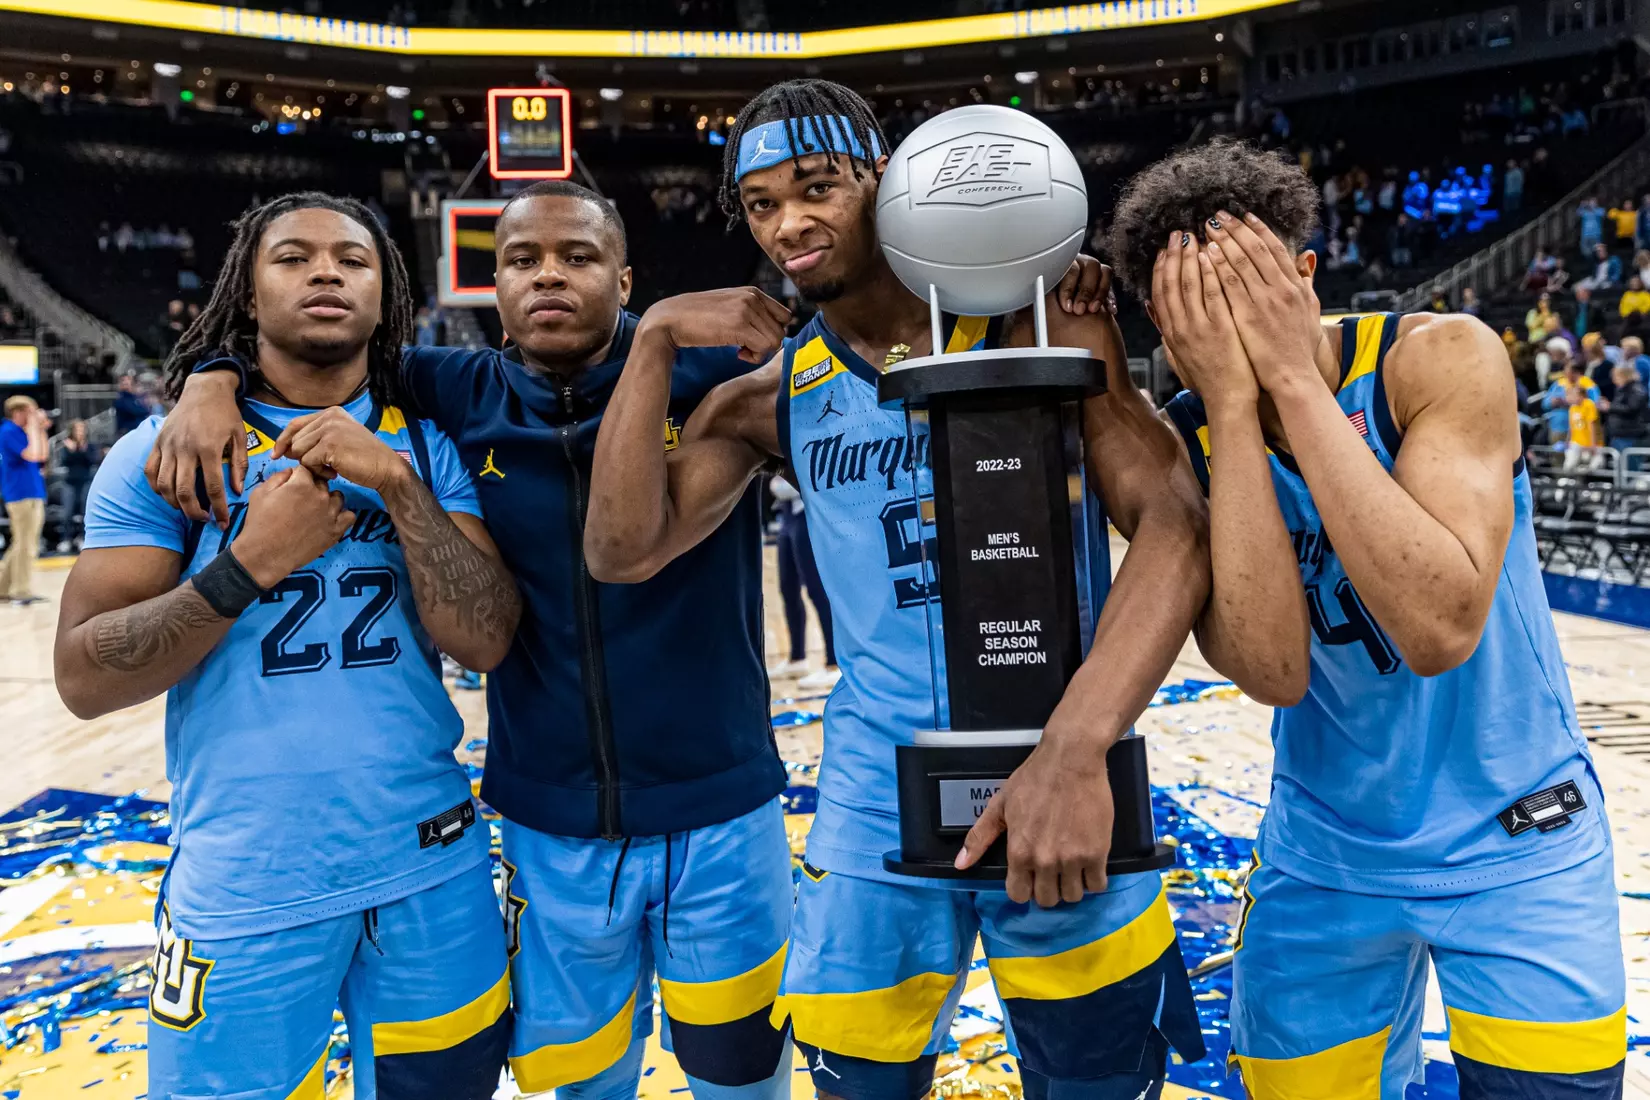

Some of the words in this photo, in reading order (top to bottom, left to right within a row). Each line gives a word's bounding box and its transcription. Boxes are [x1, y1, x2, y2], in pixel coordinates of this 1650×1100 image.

[512, 96, 547, 121] 0.0
[942, 144, 1015, 166] BIG
[932, 162, 1032, 185] EAST
[957, 185, 1024, 195] CONFERENCE
[976, 458, 1022, 472] 2022-23
[988, 532, 1020, 545] MEN'S
[971, 546, 1039, 561] BASKETBALL
[259, 566, 402, 677] 22
[979, 619, 1042, 634] REGULAR
[1304, 576, 1402, 675] 4
[985, 635, 1038, 650] SEASON
[978, 651, 1047, 666] CHAMPION
[1563, 790, 1577, 803] 46
